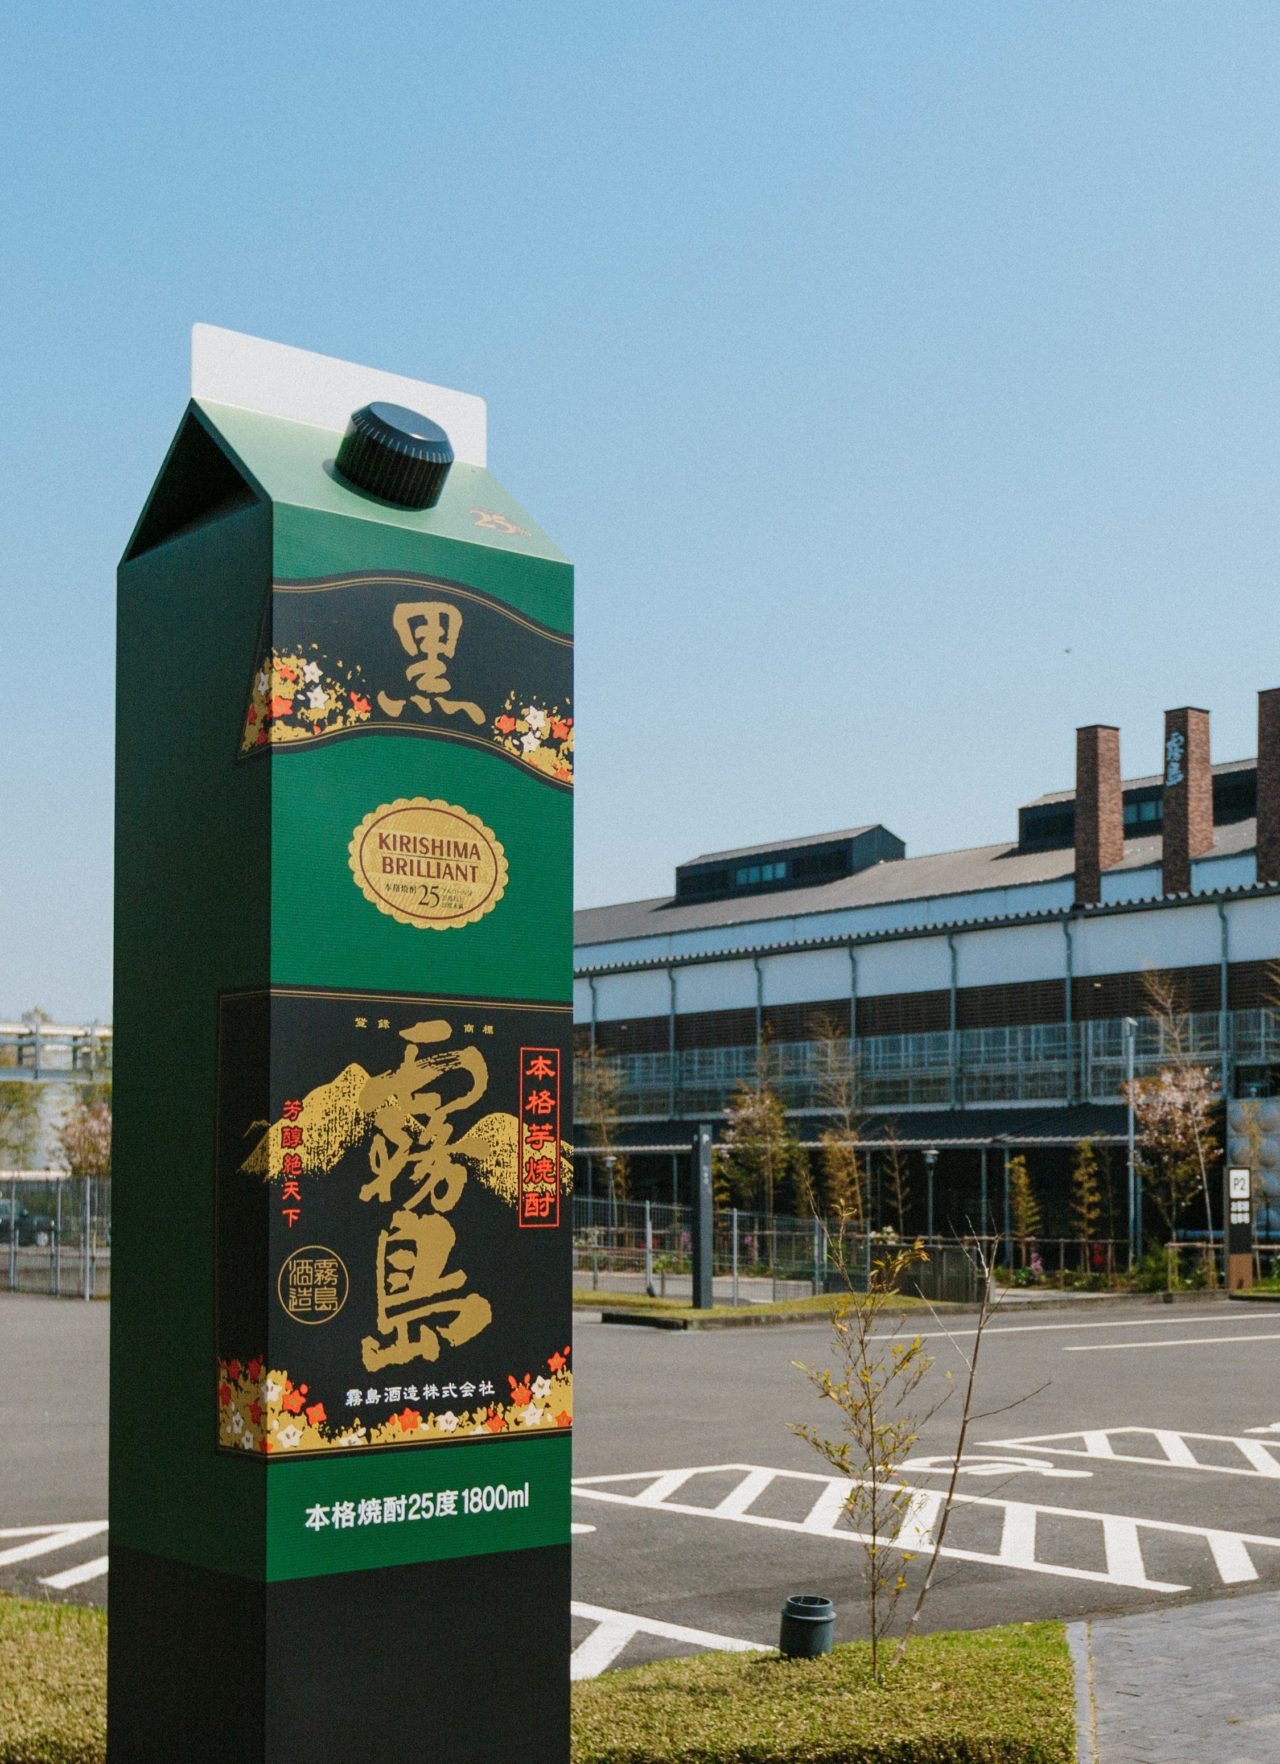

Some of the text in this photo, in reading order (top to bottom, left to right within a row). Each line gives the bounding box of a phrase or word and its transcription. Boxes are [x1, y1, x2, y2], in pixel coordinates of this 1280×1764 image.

[378, 832, 481, 861] KIRISHIMA
[382, 856, 479, 883] BRILLIANT
[418, 884, 440, 908] 25
[524, 1055, 556, 1218] 本格芋焼酎
[281, 1099, 303, 1229] 芳醇絶天下
[358, 1019, 492, 1372] 霧島
[1233, 1177, 1246, 1191] P2
[344, 1380, 496, 1407] 霧島酒造株式会社
